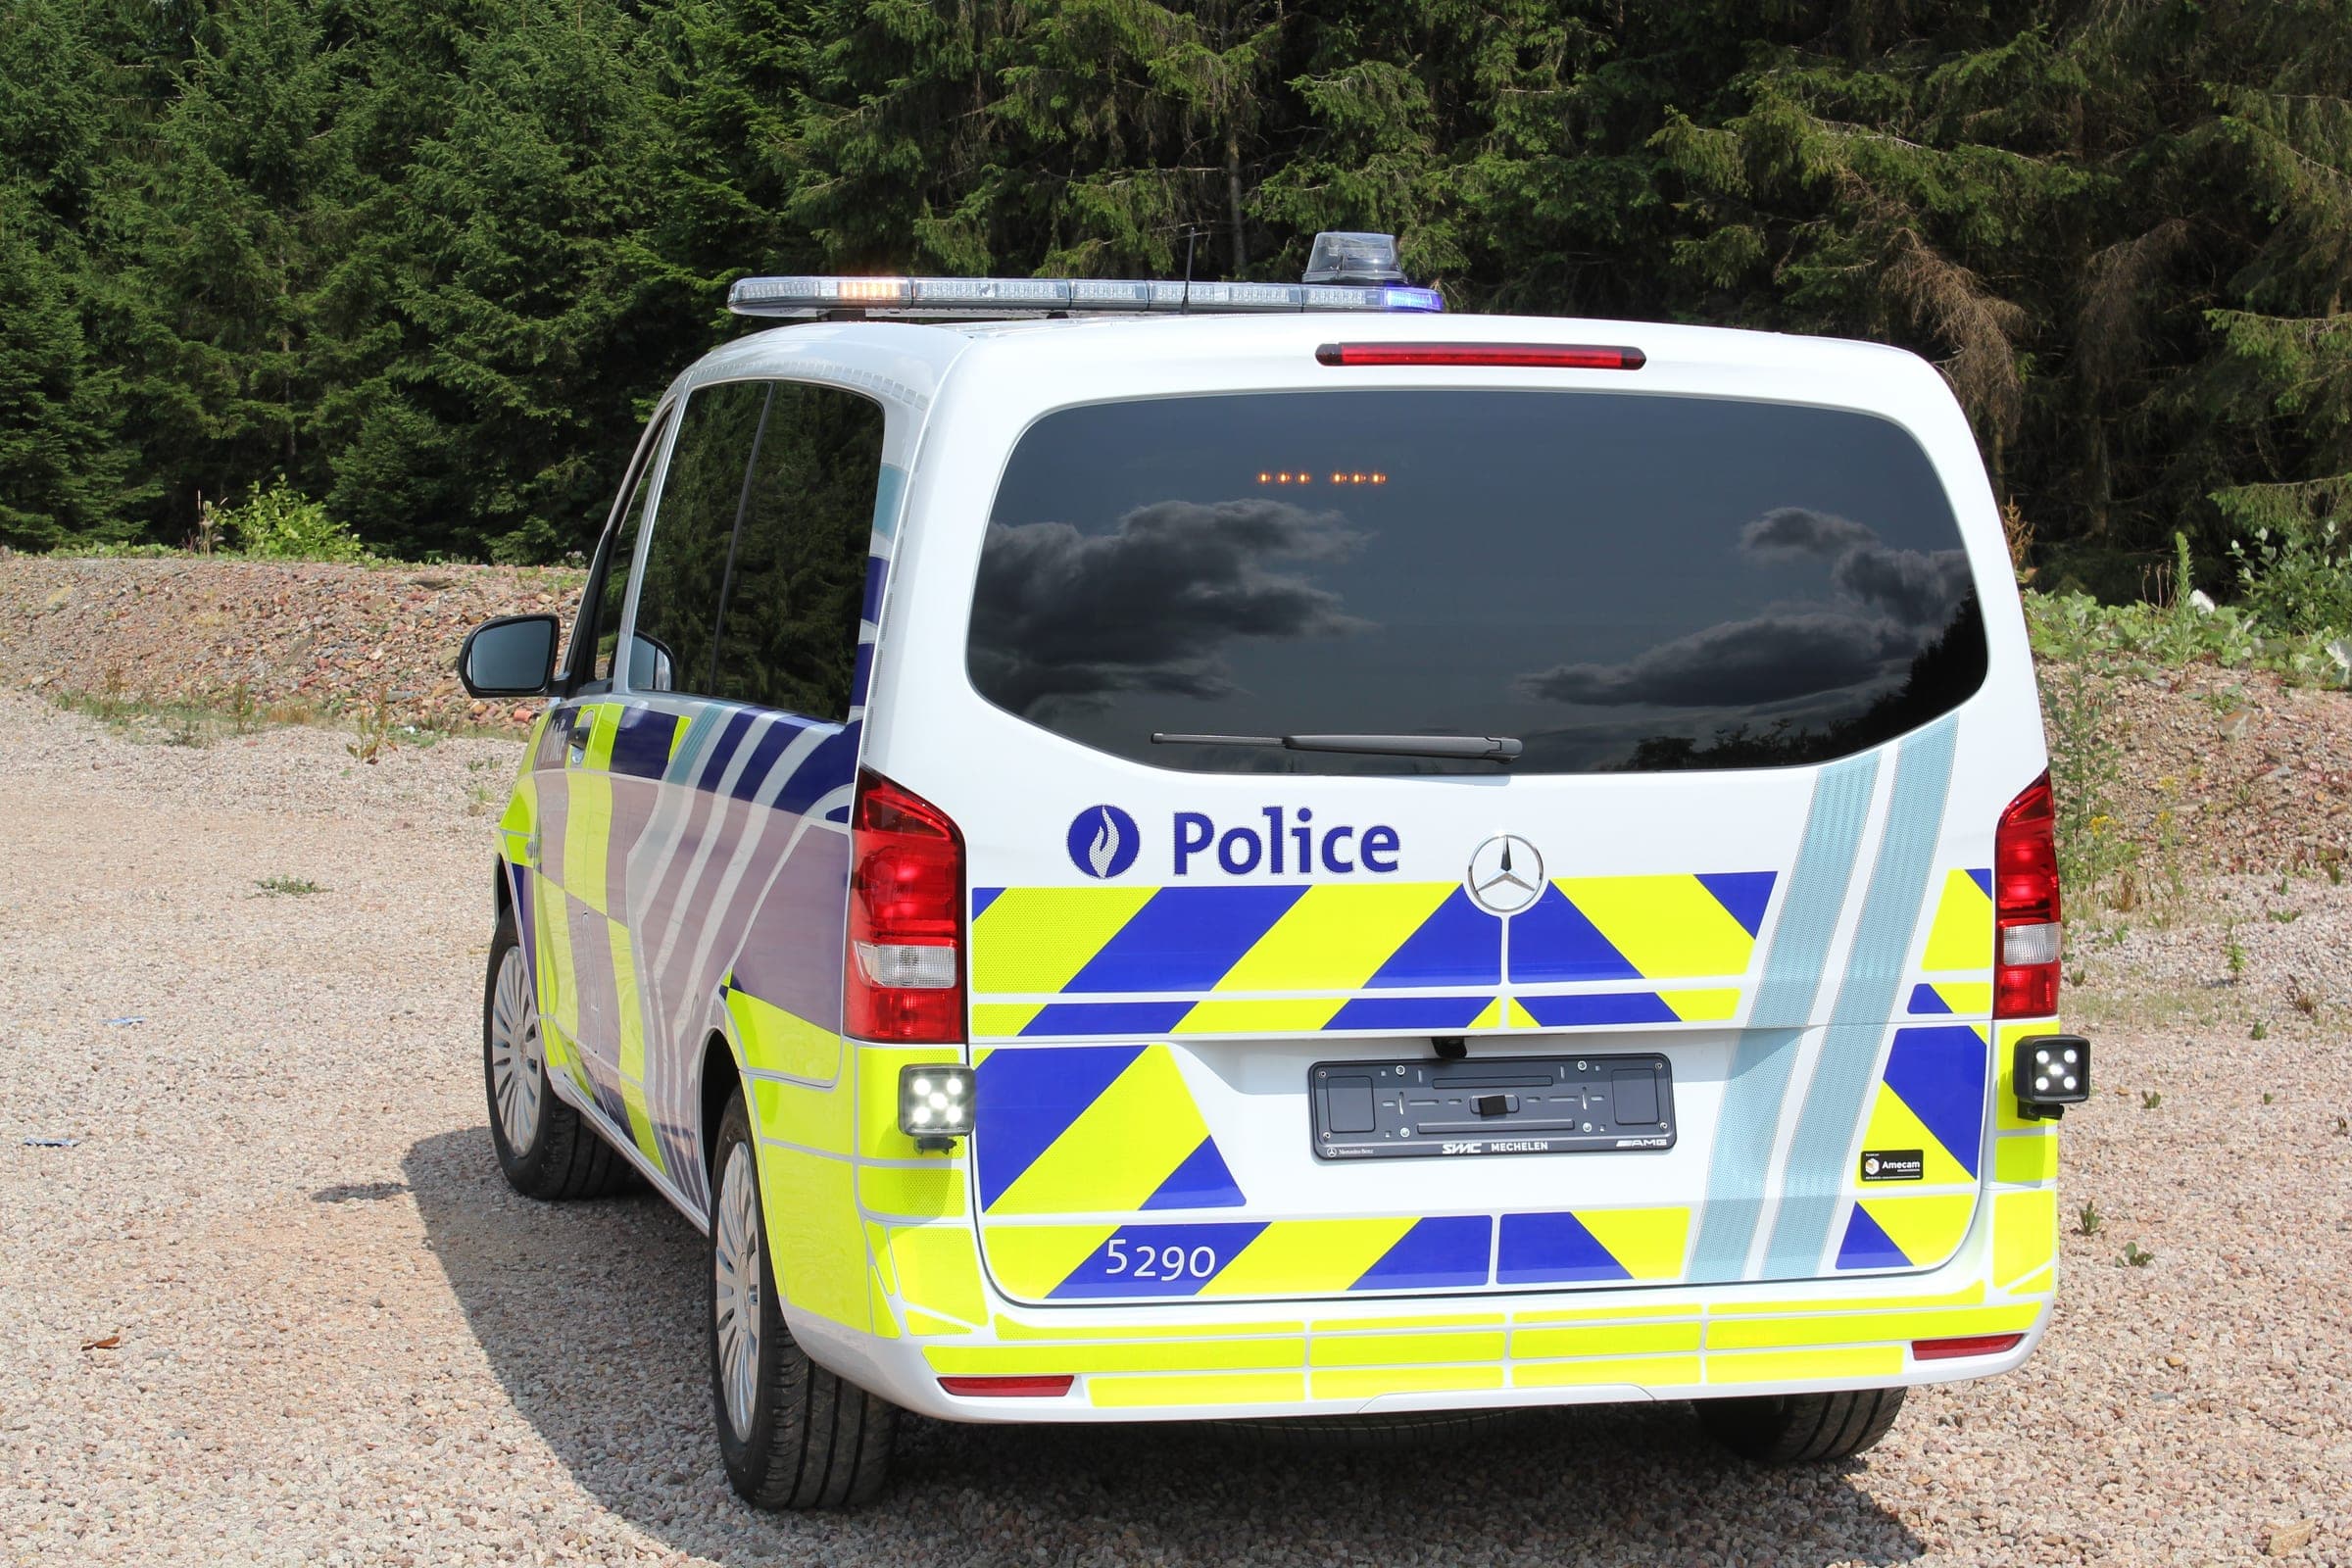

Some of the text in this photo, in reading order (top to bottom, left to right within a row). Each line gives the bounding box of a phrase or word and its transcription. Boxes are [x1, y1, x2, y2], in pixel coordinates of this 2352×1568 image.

[1174, 806, 1399, 875] Police
[1491, 1141, 1548, 1152] MECHELEN
[1632, 1138, 1667, 1147] AMG
[1882, 1160, 1920, 1169] Amecam
[1105, 1239, 1216, 1281] 5290
